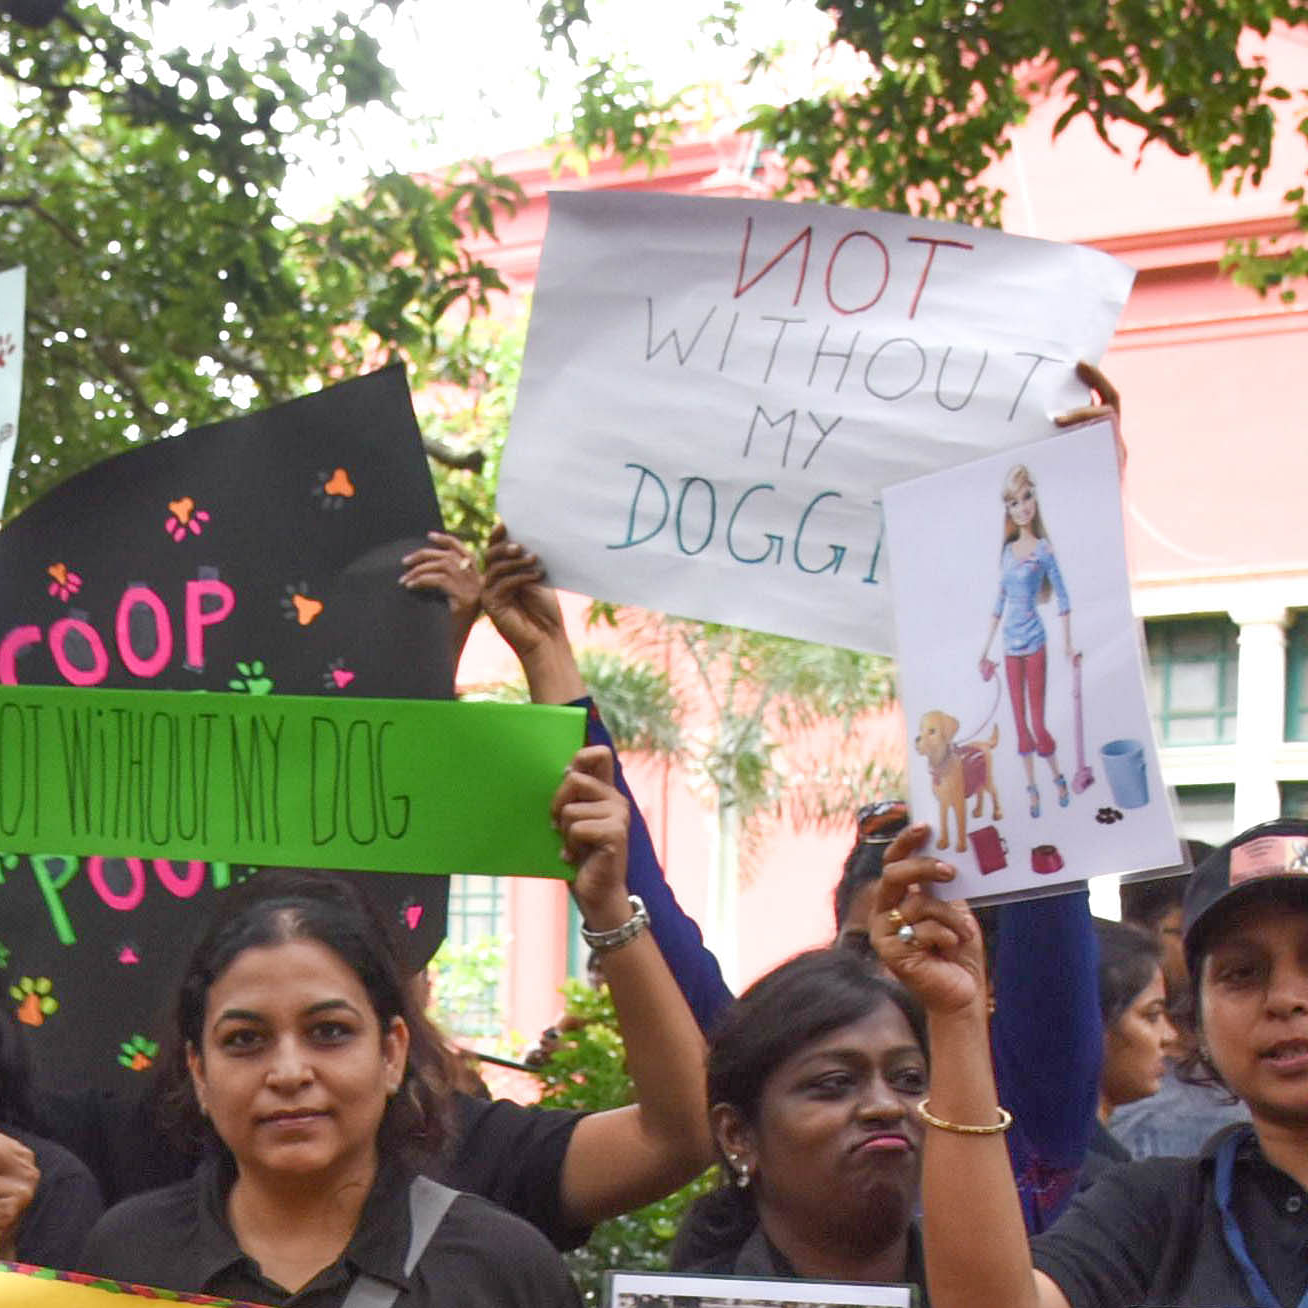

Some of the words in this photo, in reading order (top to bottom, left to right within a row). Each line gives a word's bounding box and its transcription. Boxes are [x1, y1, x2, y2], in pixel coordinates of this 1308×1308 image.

[733, 216, 974, 321] NOT
[645, 297, 1063, 421] WITHOUT
[743, 405, 842, 470] MY
